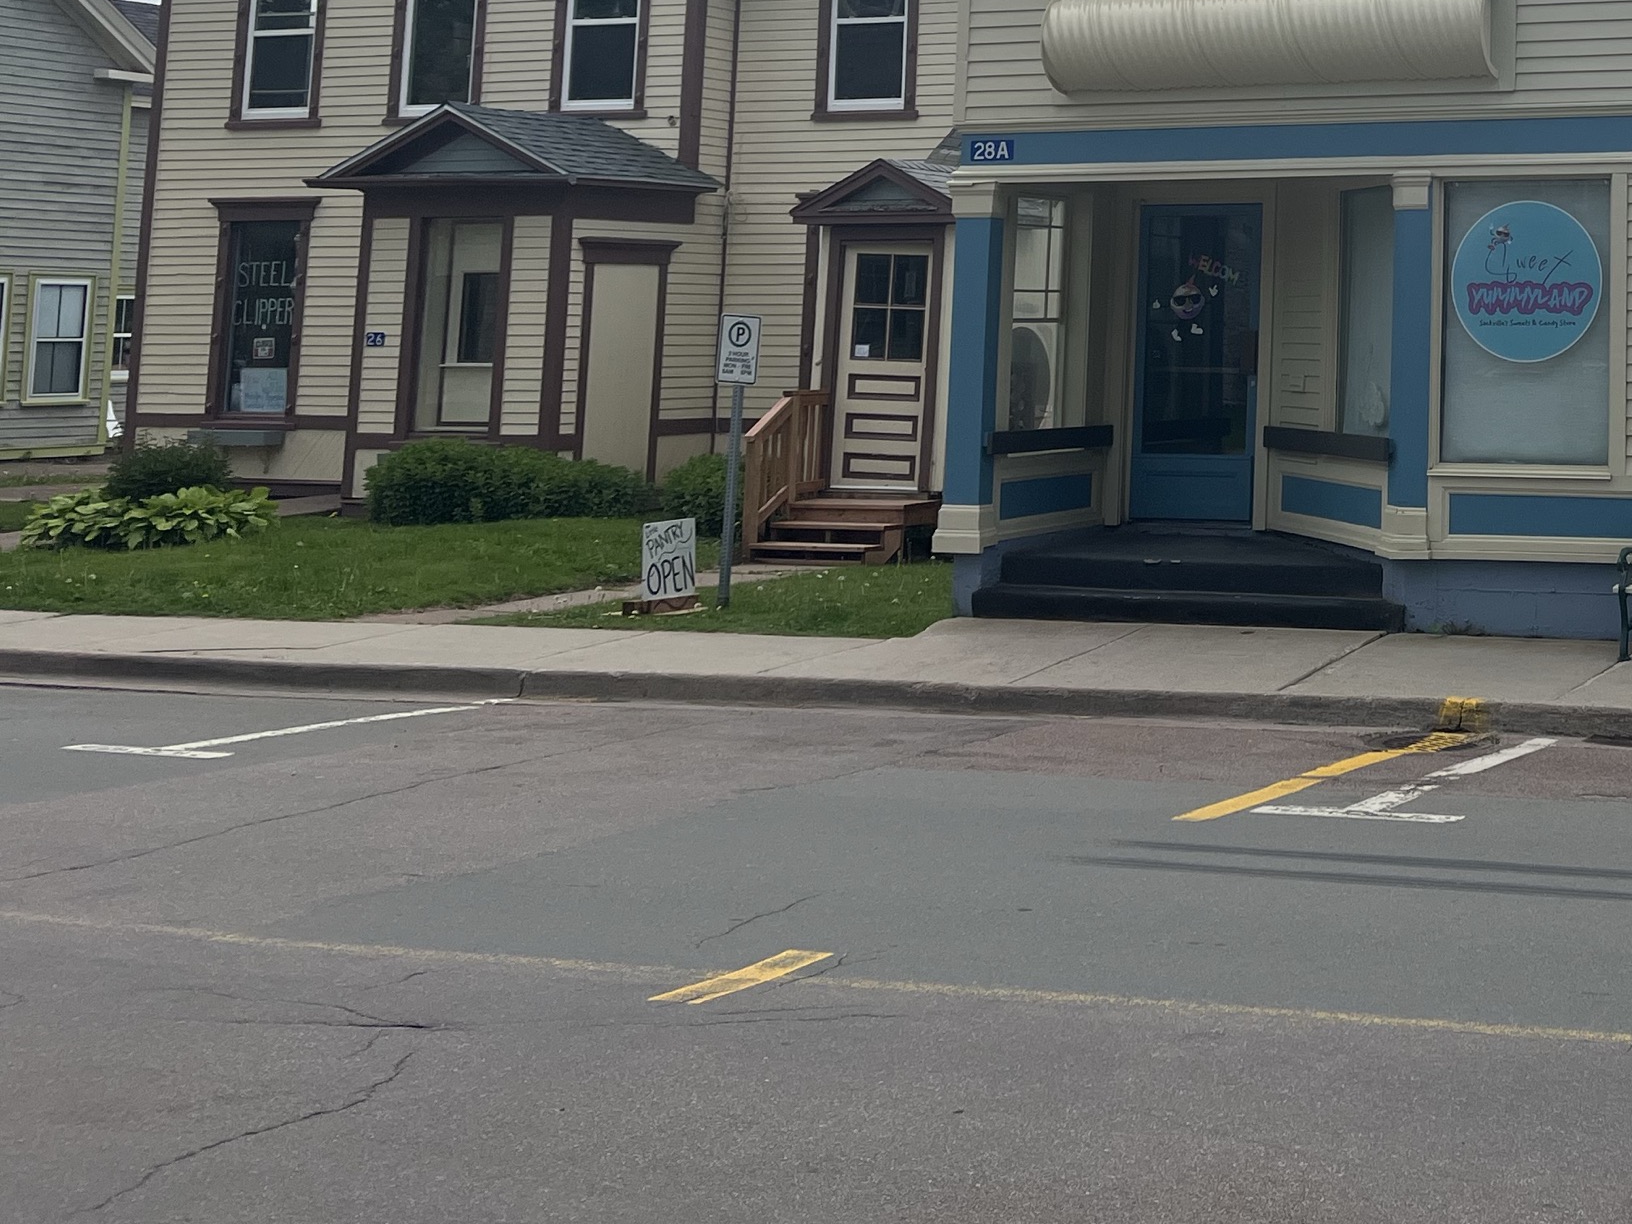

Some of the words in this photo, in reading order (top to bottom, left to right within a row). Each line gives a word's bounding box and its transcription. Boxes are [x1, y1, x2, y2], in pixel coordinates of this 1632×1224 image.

[973, 141, 1009, 160] 28A
[238, 261, 290, 287] STEEL
[233, 297, 295, 325] CLIPPER
[1470, 283, 1590, 313] YUMMYLAND
[367, 333, 382, 346] 26
[645, 521, 684, 559] PANTRY
[646, 551, 696, 595] OPEN
